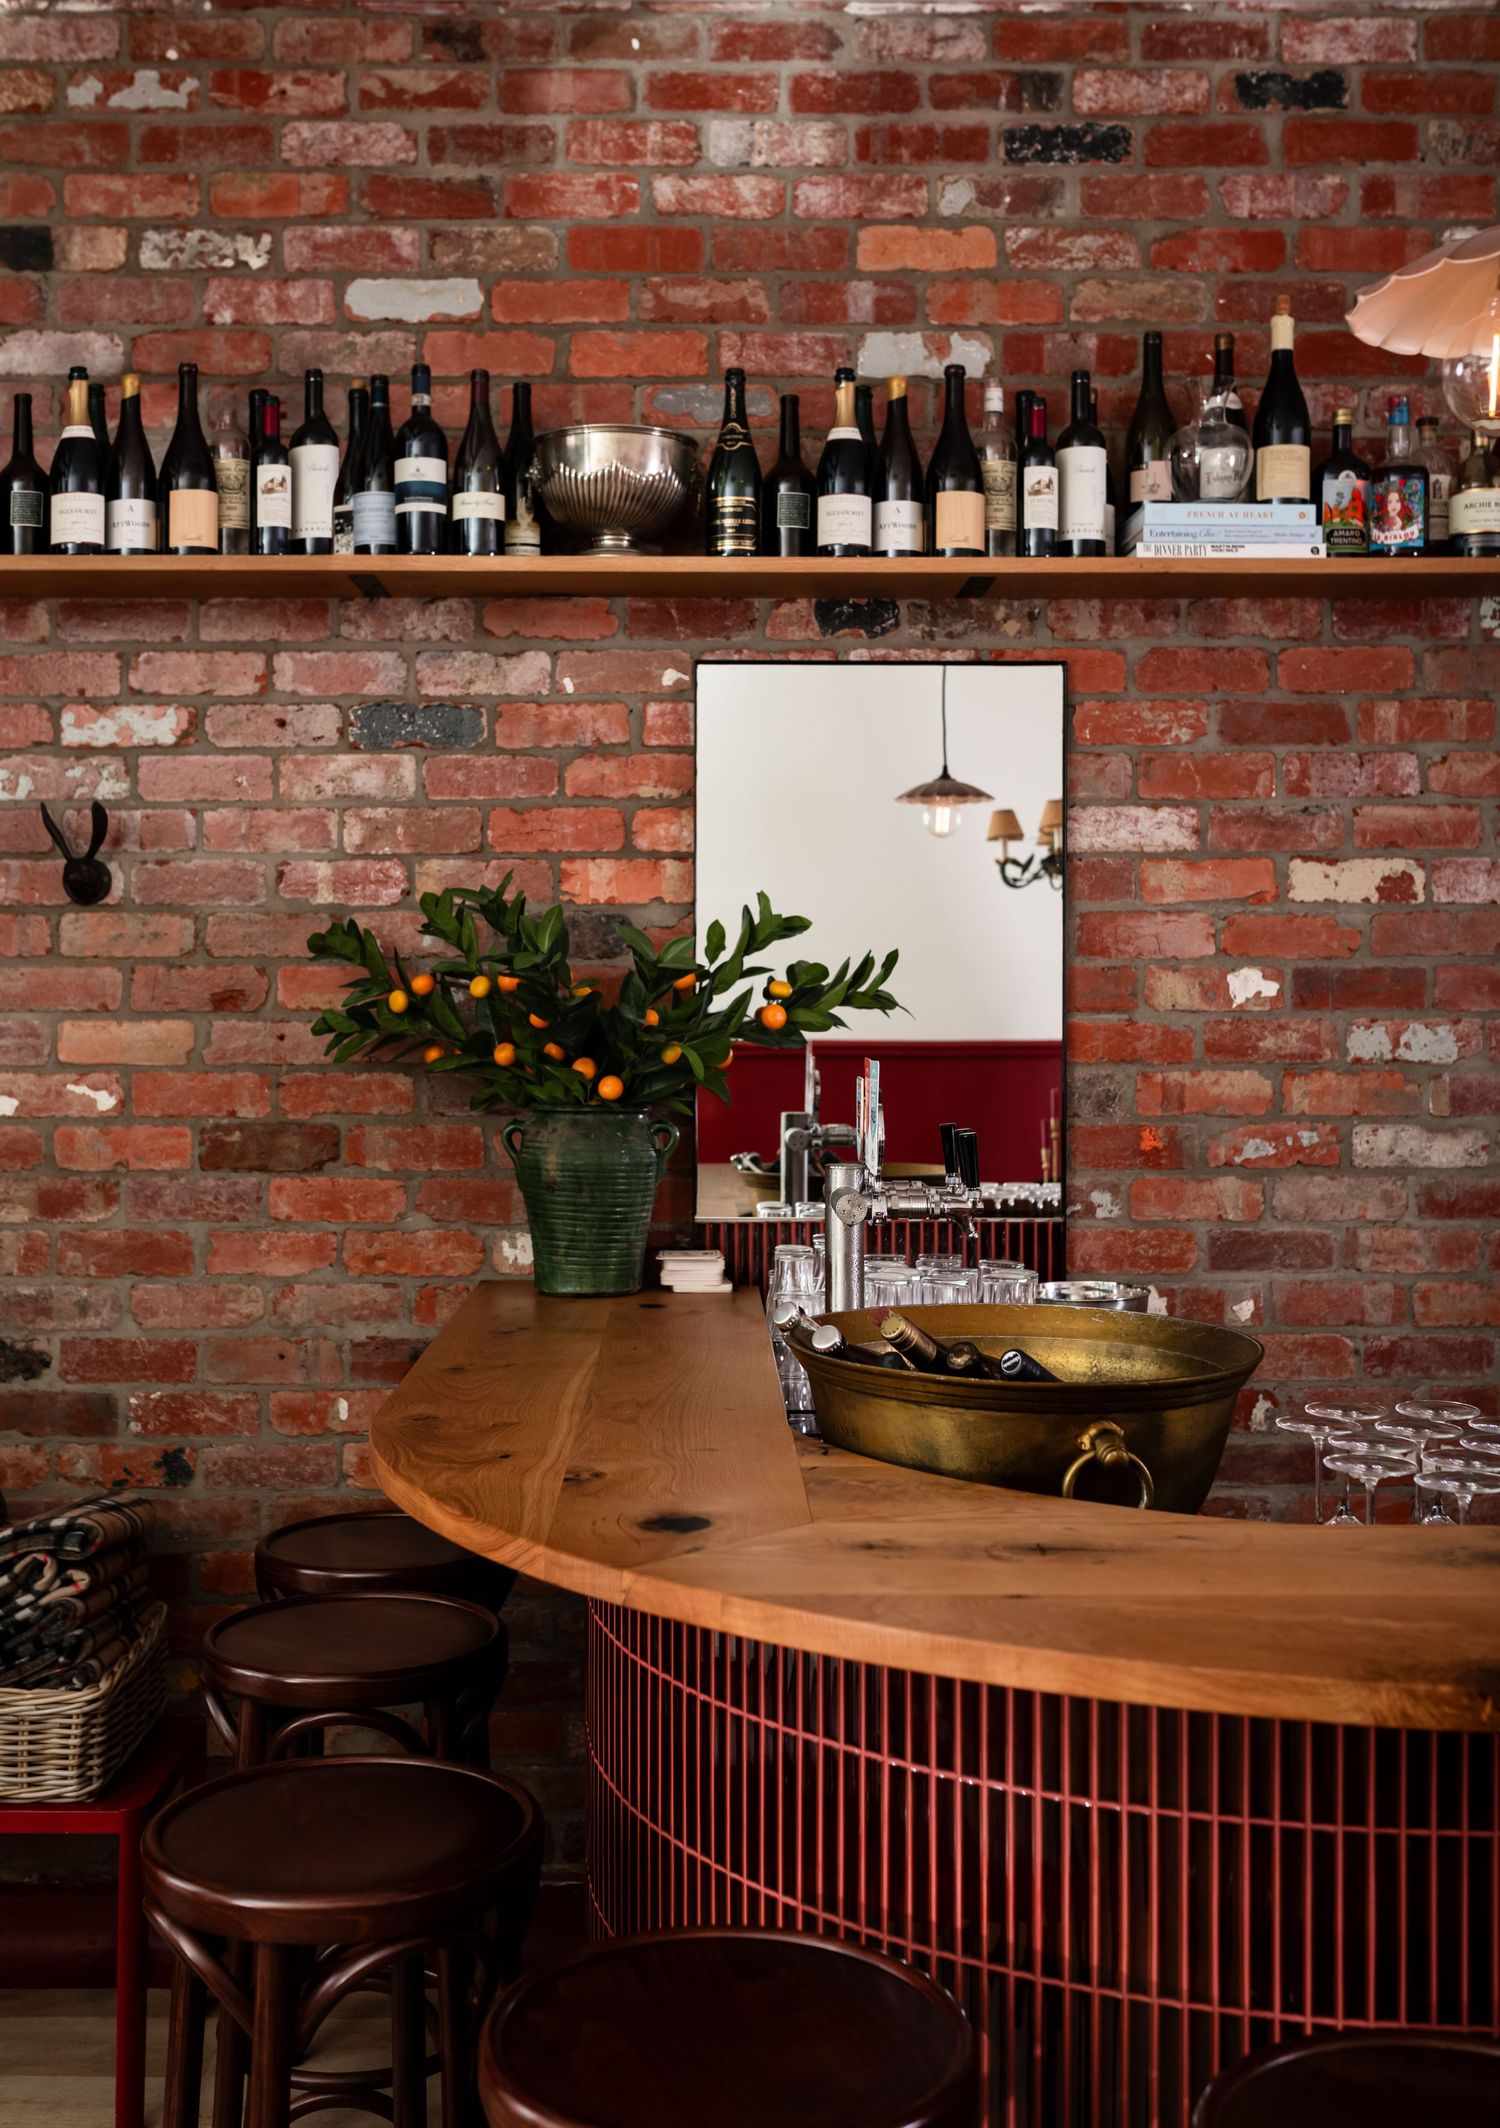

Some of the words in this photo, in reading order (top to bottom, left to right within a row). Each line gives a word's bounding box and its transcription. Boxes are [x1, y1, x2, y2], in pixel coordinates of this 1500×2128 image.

[1243, 511, 1273, 519] HEART
[1149, 528, 1198, 538] Entertaining
[1332, 529, 1360, 537] AMARO
[1154, 543, 1182, 556] DINNER
[1184, 544, 1207, 556] PARTY
